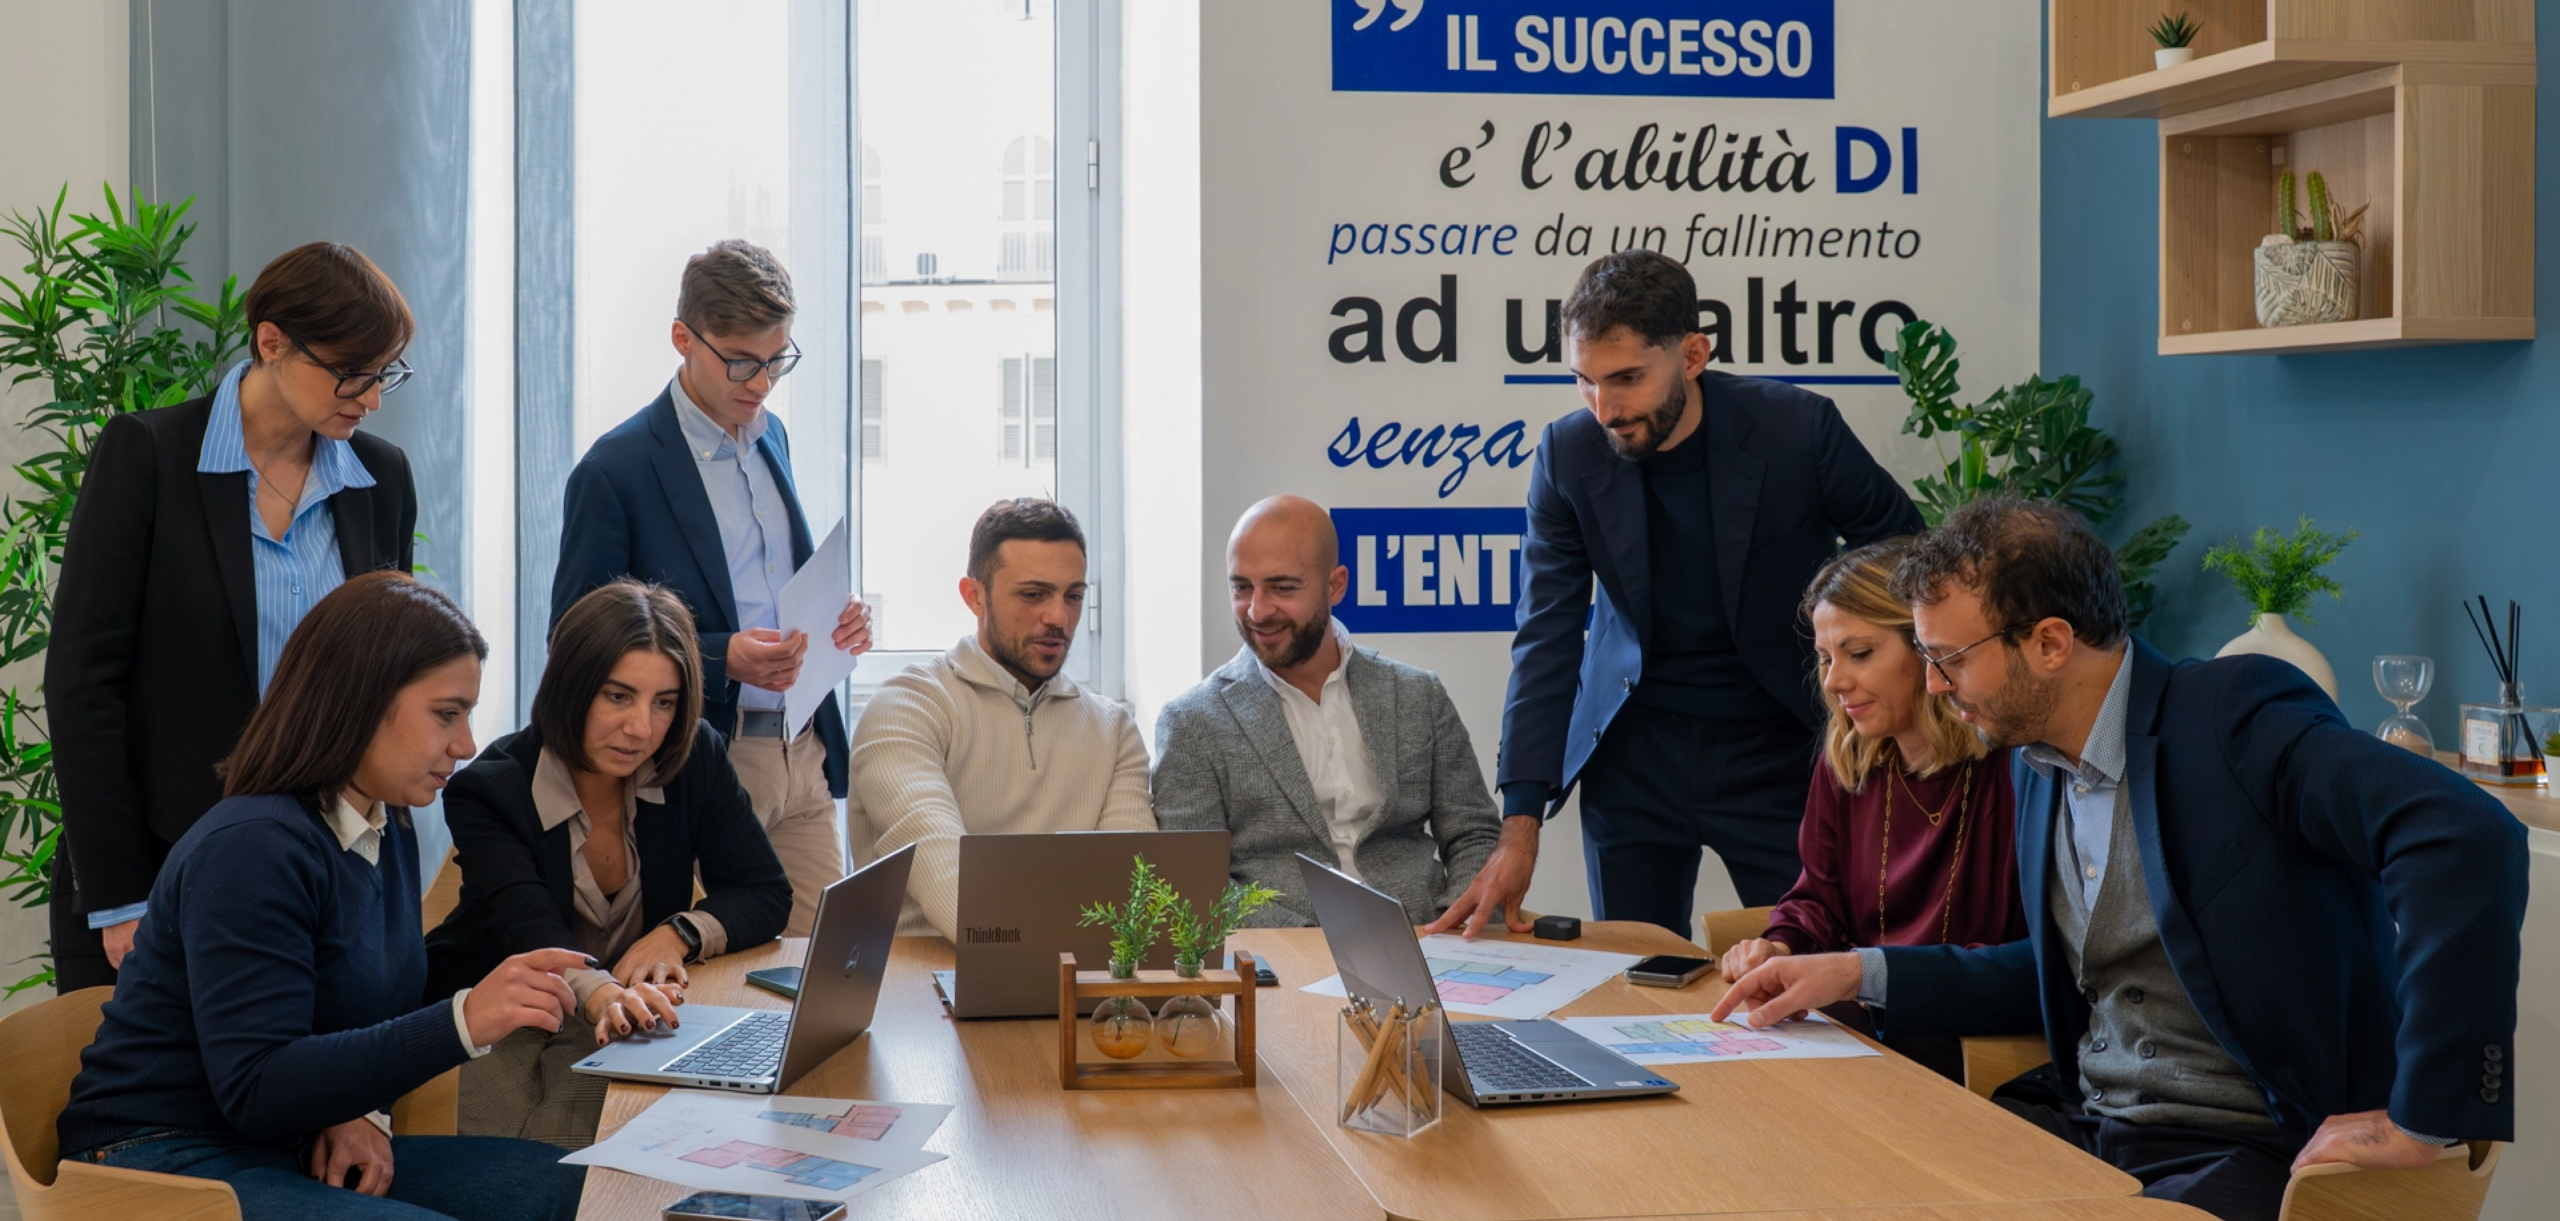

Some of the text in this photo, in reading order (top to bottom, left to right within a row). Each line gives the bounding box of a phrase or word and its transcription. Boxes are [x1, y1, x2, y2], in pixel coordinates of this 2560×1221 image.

[1447, 14, 1497, 71] IL
[1514, 15, 1812, 78] SUCCESSO
[1835, 125, 1919, 195] DI
[1327, 212, 1922, 265] passare da un fallimento
[1327, 274, 1458, 364] ad
[1698, 276, 1918, 366] altro
[1327, 416, 1534, 499] senza
[965, 926, 1021, 944] ThinkBook
